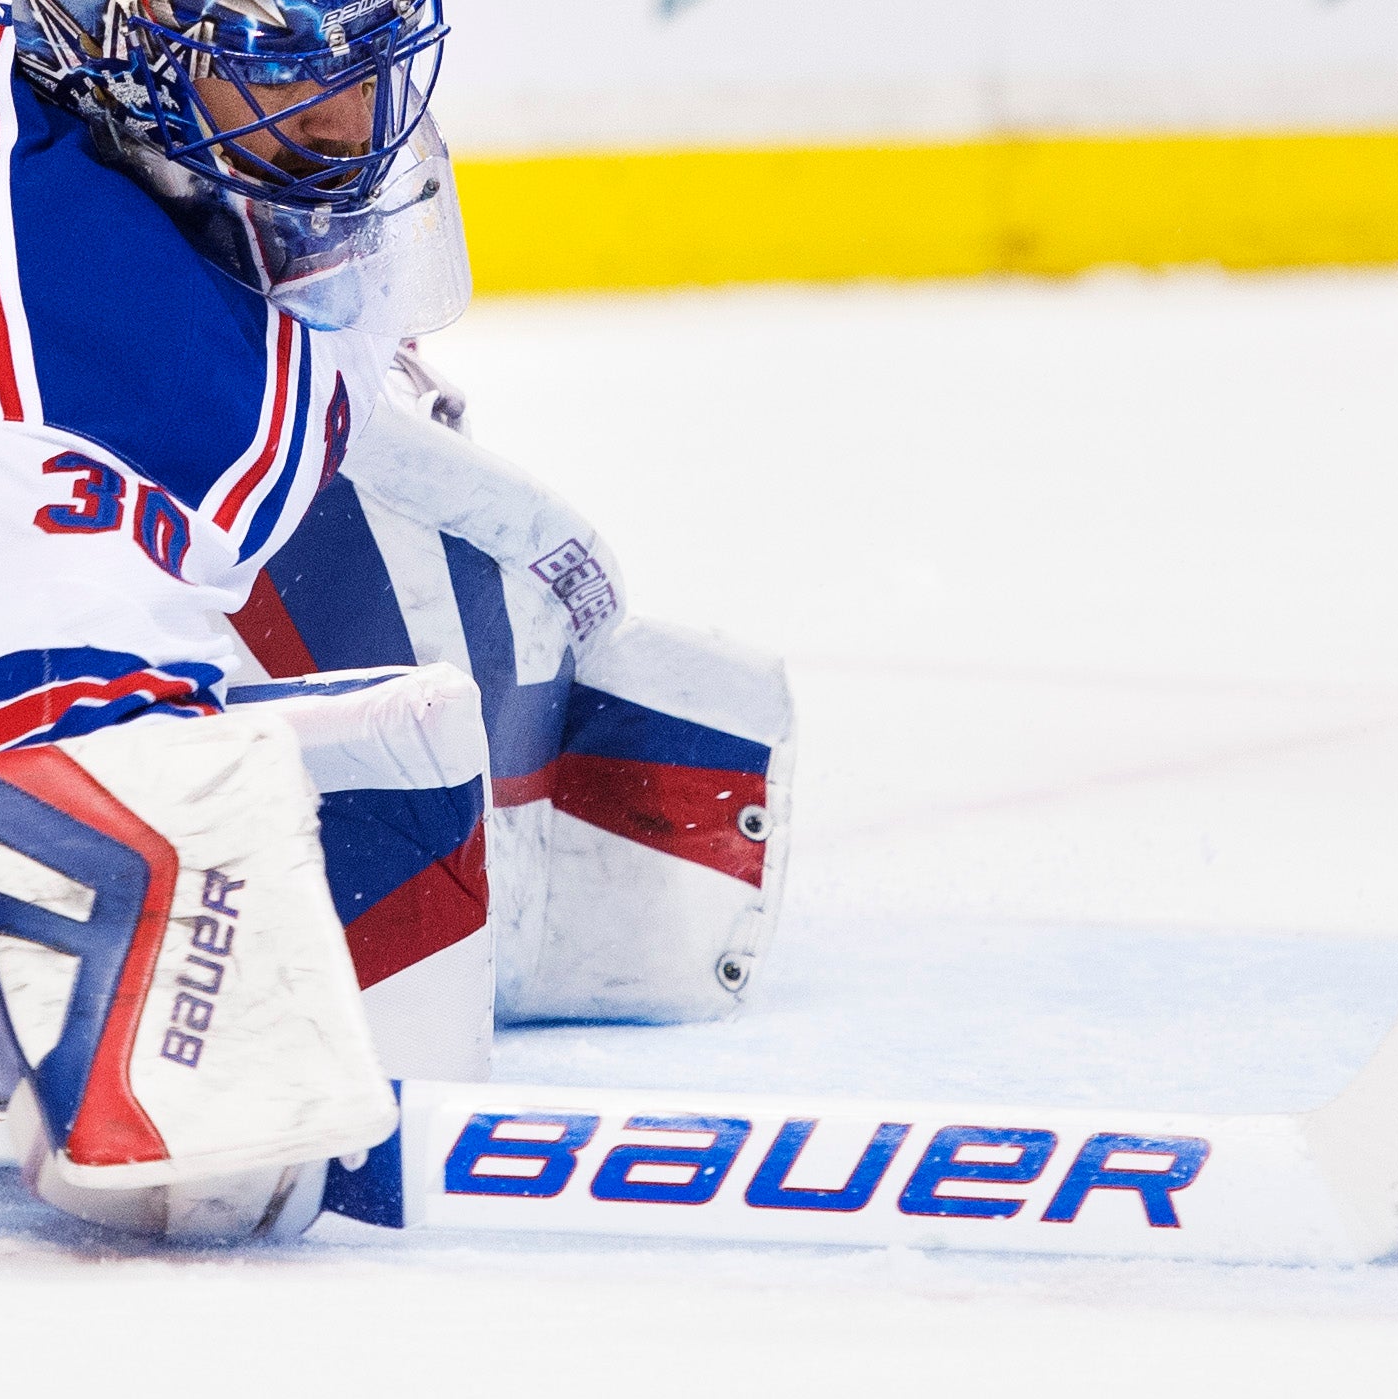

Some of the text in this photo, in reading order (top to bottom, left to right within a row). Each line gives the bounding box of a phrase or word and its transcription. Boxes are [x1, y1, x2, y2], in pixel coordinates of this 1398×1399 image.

[33, 449, 199, 586] 30
[160, 869, 246, 1069] BAUER
[443, 1110, 1212, 1229] BAUER
